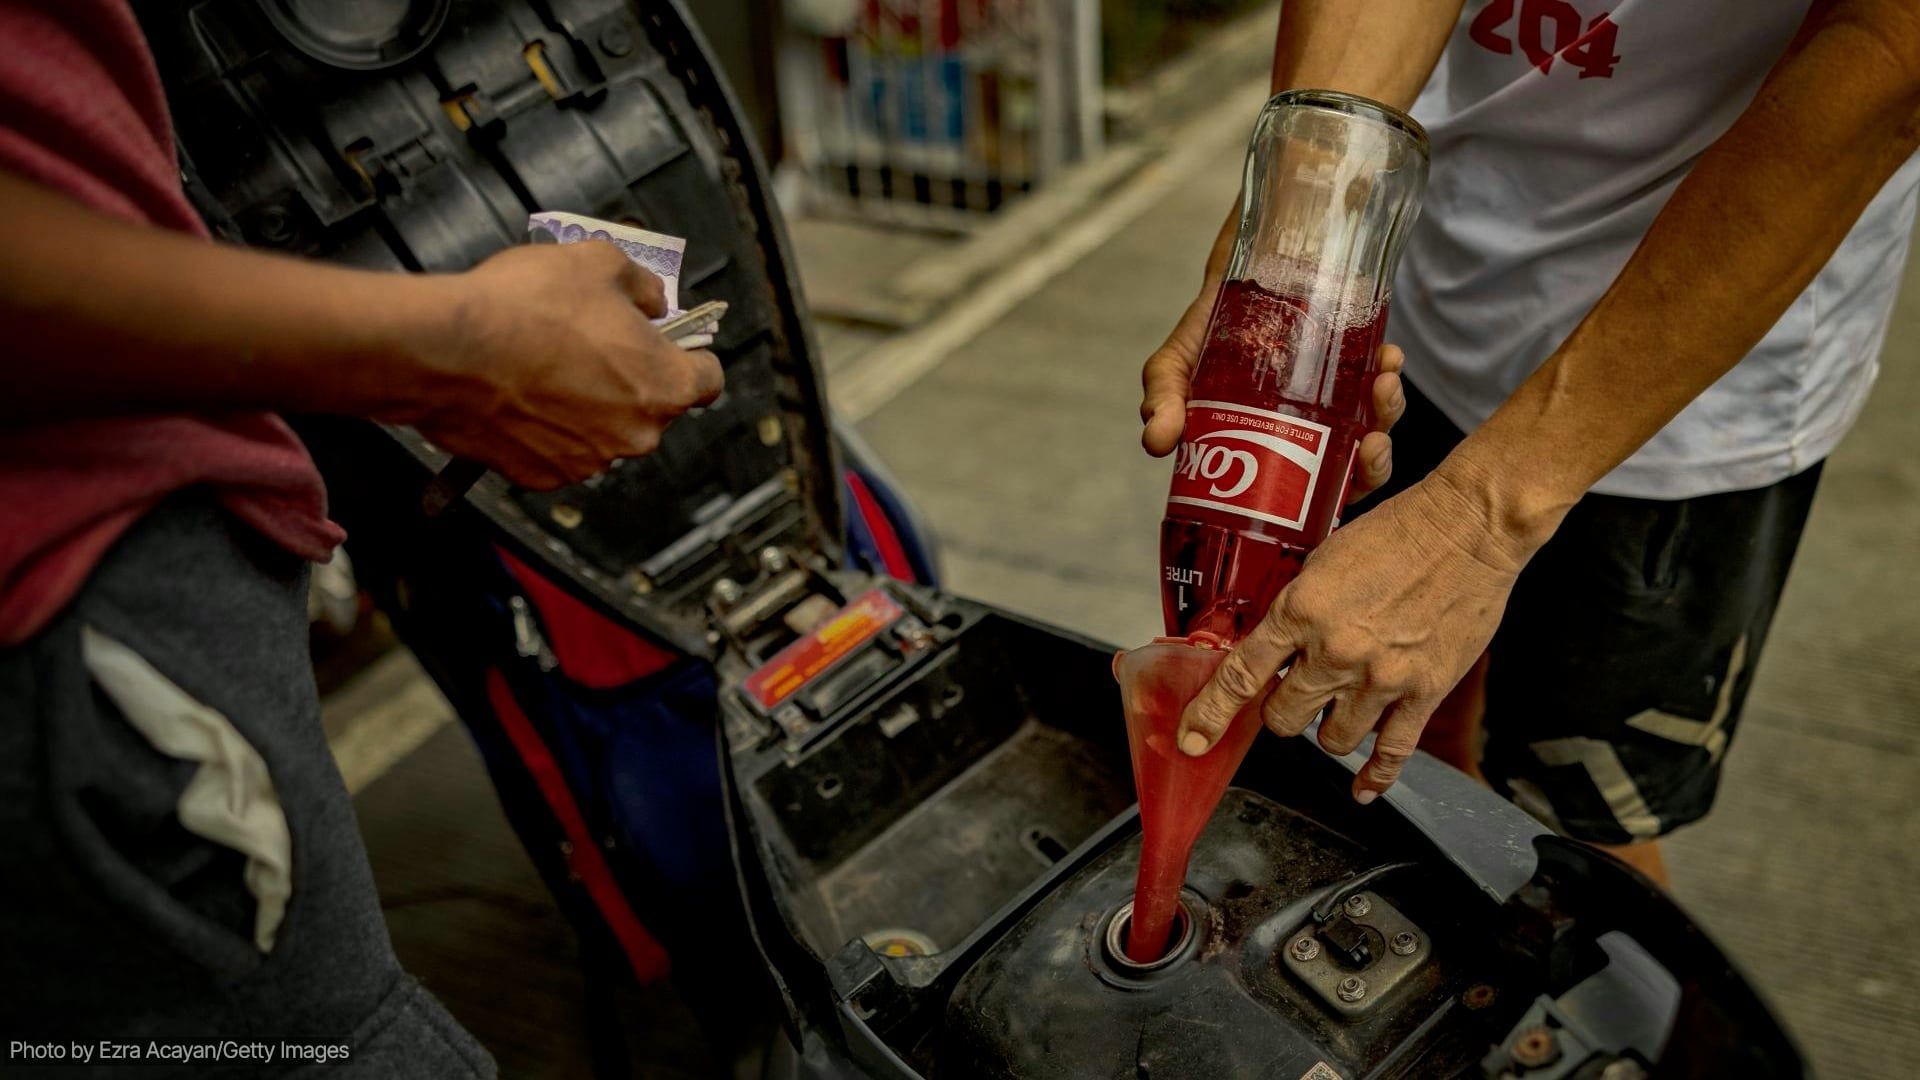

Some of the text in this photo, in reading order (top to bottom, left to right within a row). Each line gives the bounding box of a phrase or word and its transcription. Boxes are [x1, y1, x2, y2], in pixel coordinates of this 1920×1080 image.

[1211, 412, 1314, 441] BOTTLE FOR BEVERAGE USE ONLY
[1175, 441, 1259, 499] Coke
[1165, 566, 1203, 587] LITRE
[1178, 585, 1189, 611] 1
